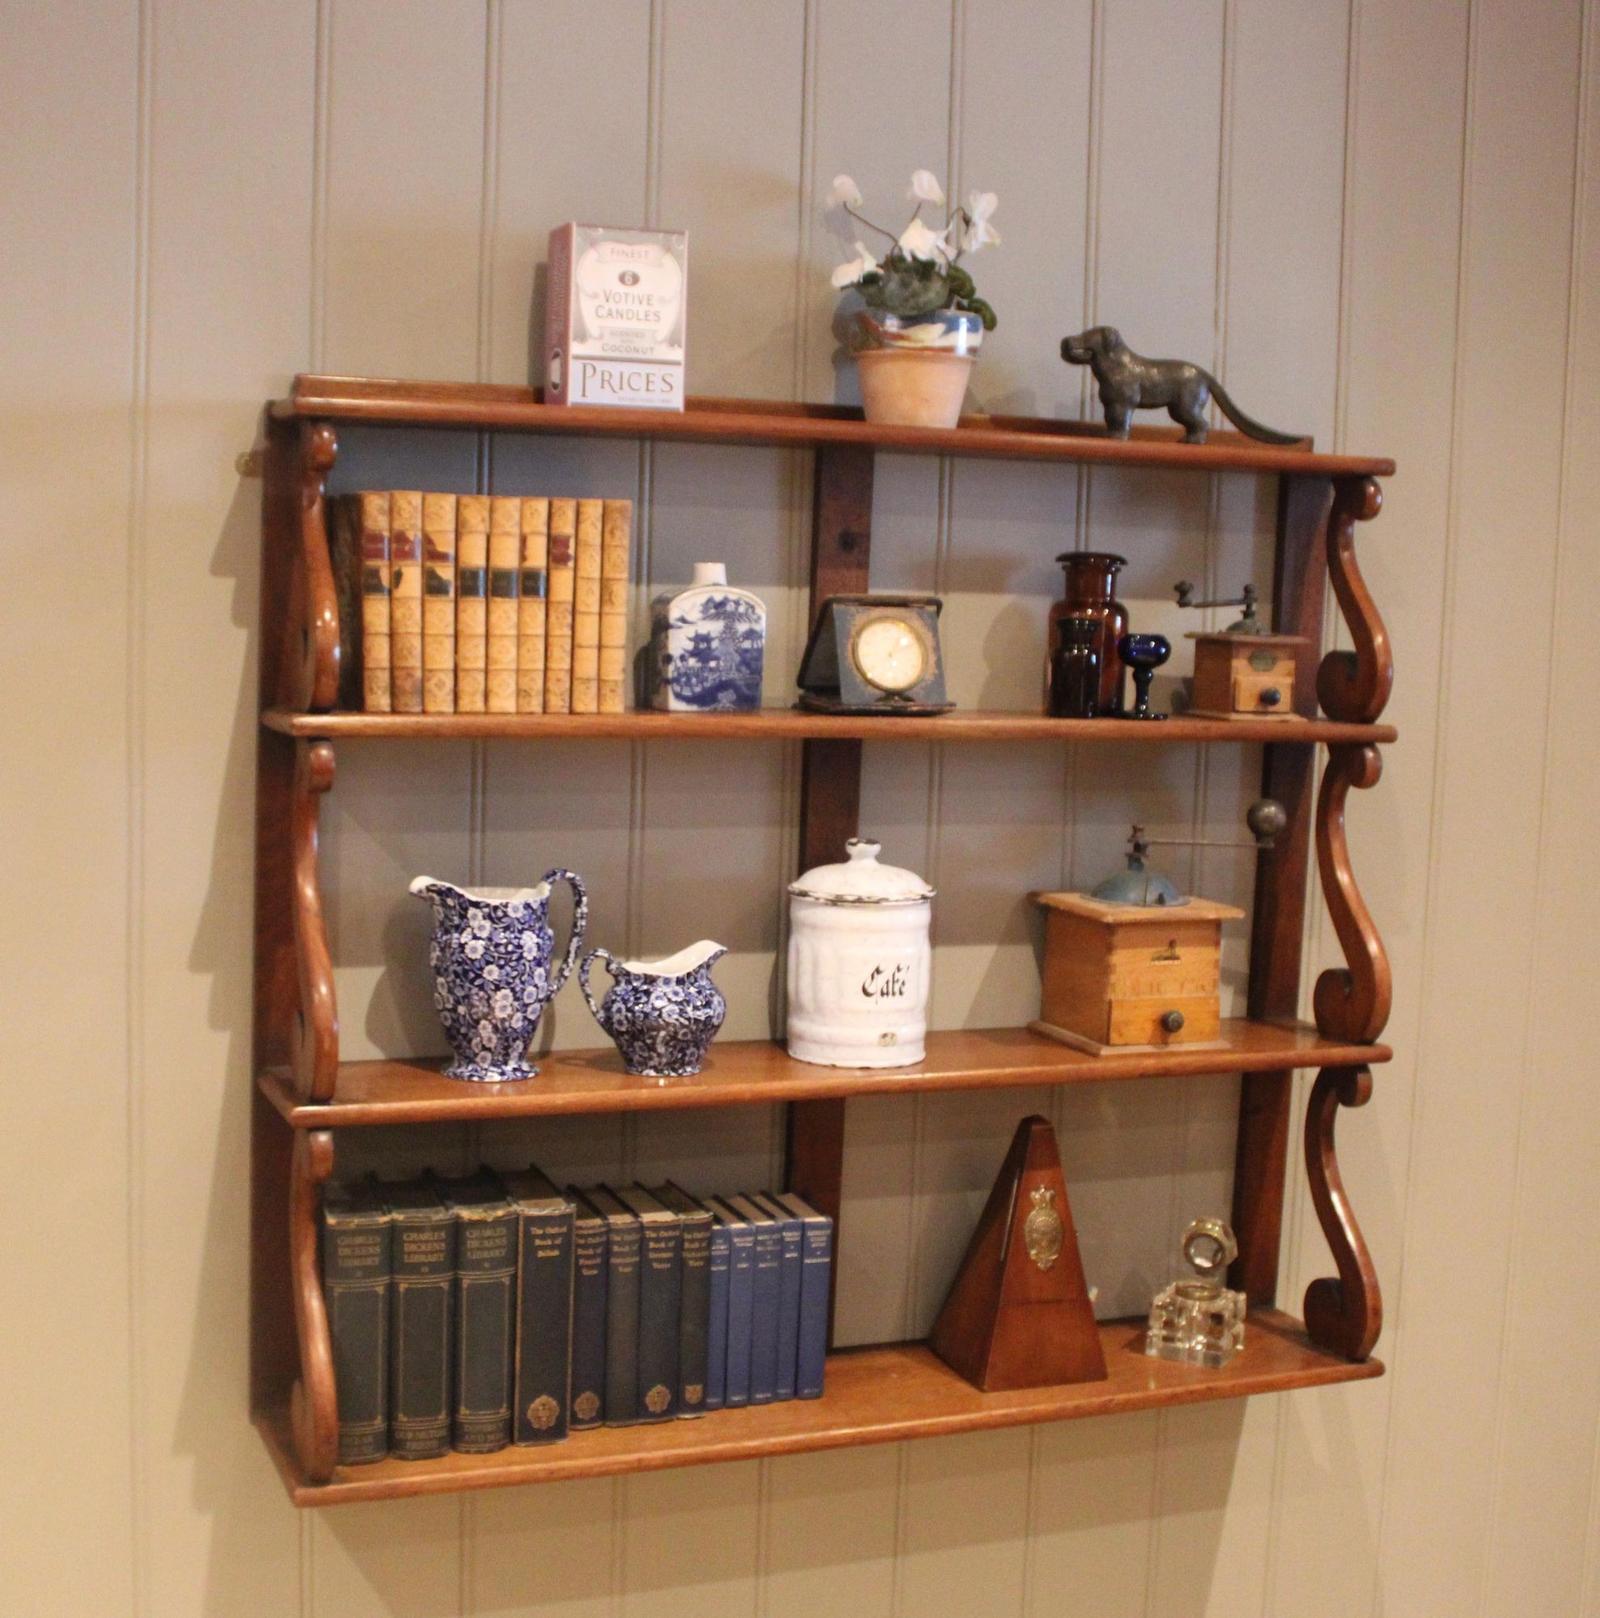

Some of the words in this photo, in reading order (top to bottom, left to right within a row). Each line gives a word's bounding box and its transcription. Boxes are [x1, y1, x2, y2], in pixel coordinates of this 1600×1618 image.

[610, 247, 650, 259] FINEST
[602, 288, 655, 307] VOTIVE
[594, 305, 662, 322] CANDLES
[601, 343, 655, 355] COCONUT
[580, 362, 675, 398] PRICES
